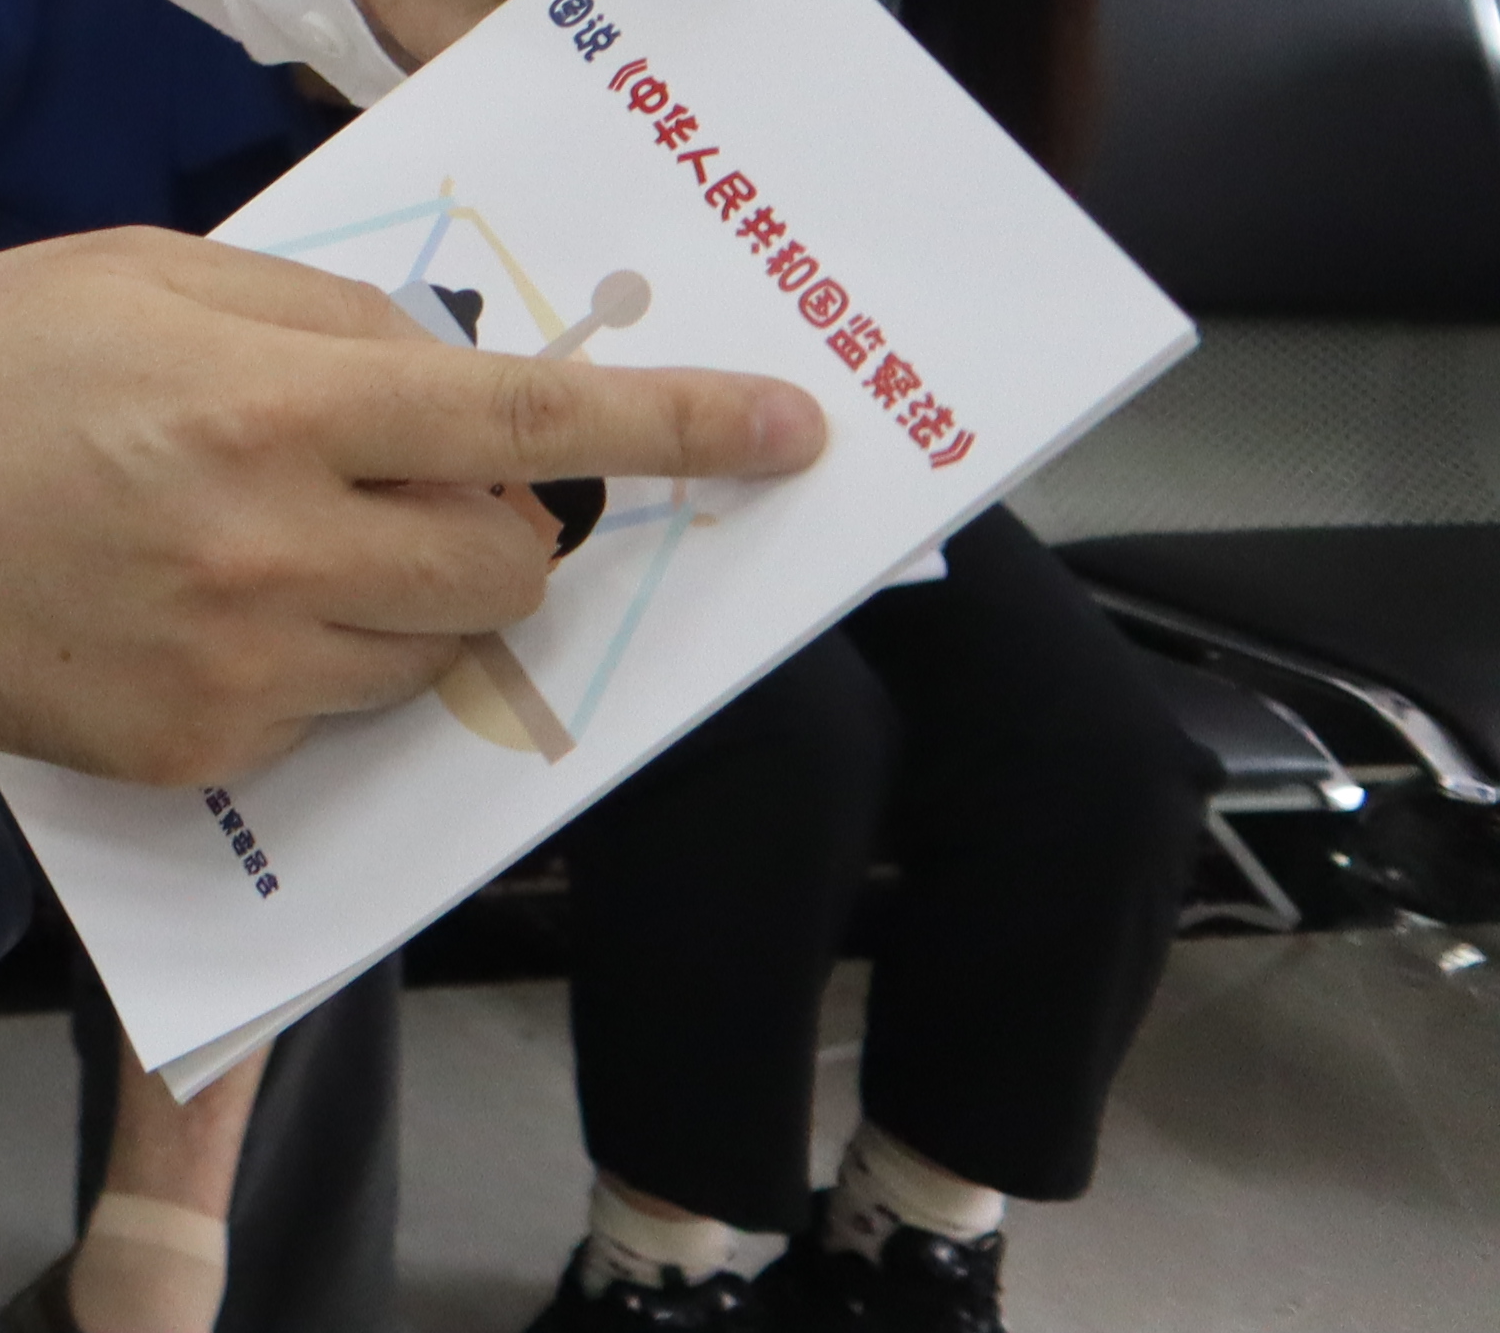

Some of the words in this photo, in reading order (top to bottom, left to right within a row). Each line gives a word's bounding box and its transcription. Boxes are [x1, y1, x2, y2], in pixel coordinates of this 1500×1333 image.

[202, 785, 280, 900] 监察委员会
